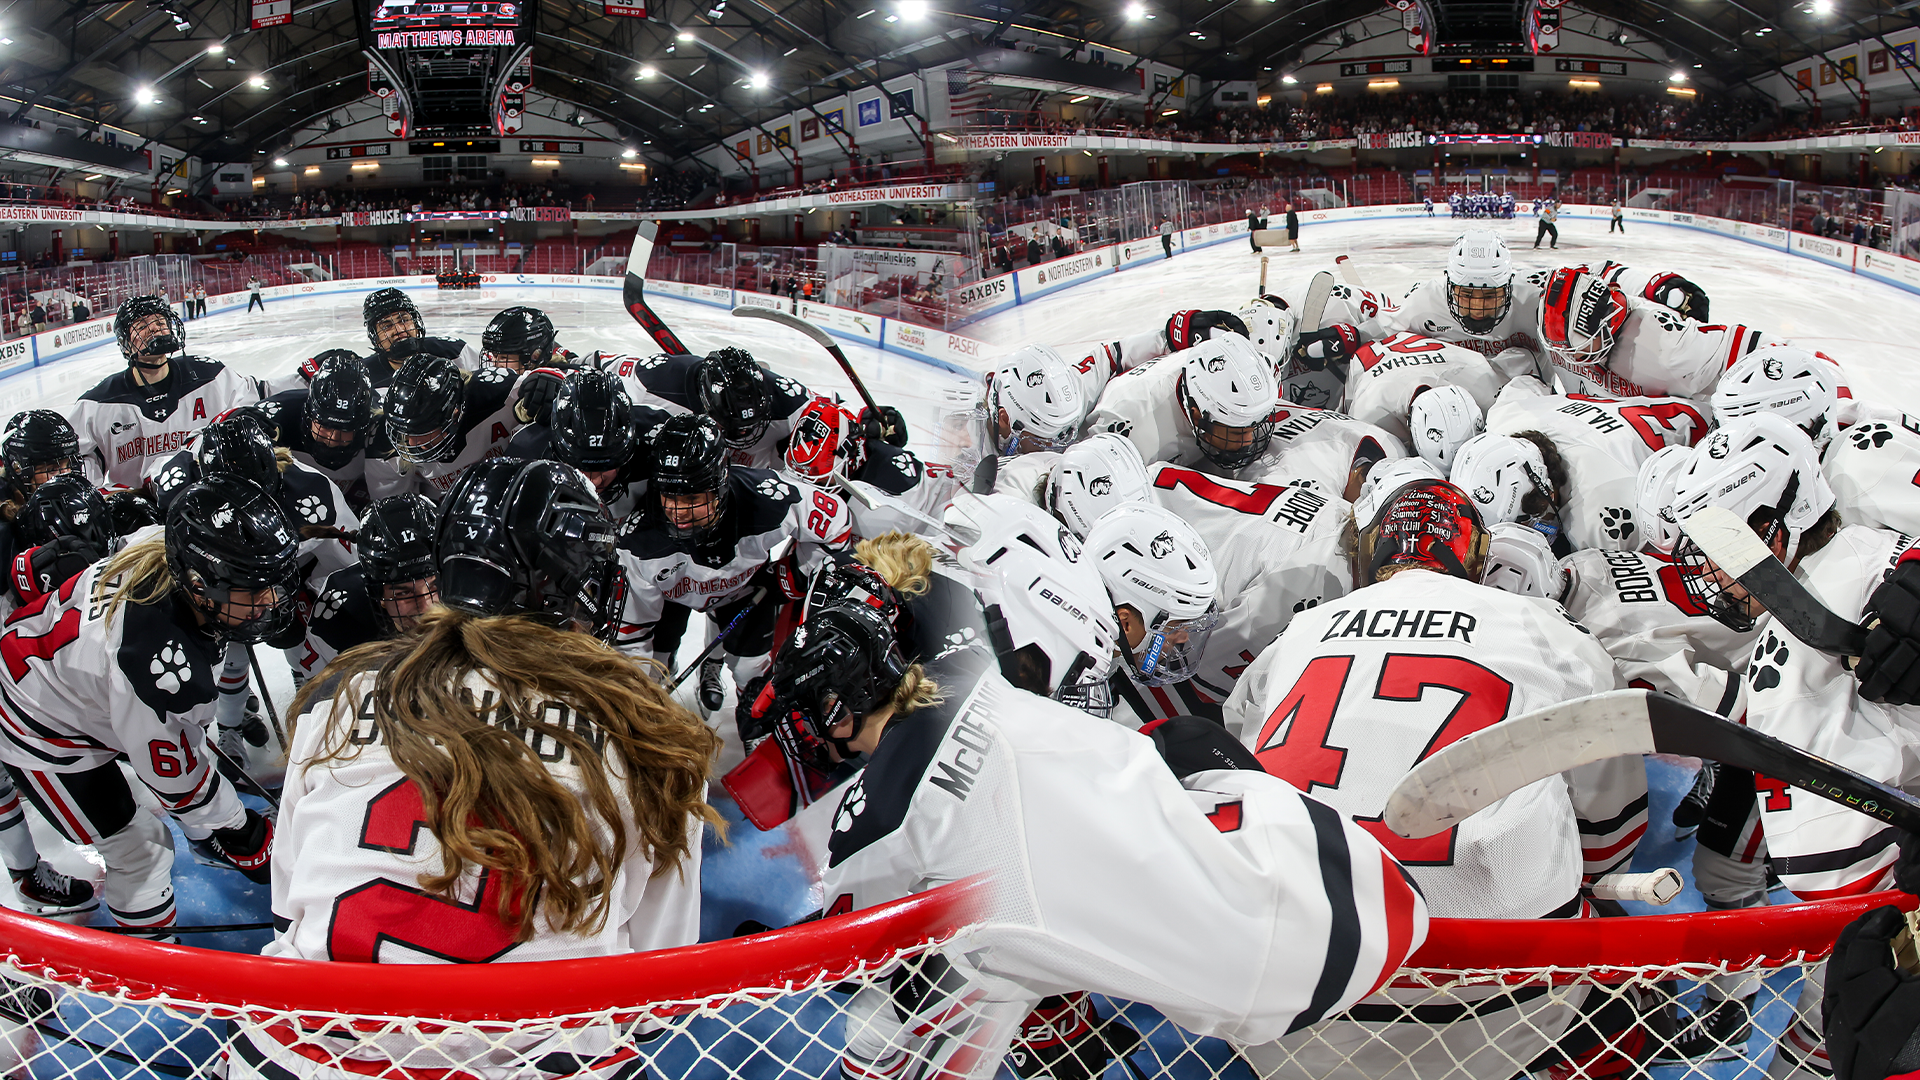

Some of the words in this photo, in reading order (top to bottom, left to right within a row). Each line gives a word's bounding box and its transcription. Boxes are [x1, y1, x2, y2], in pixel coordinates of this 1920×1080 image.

[403, 6, 409, 14] 0
[430, 4, 445, 12] 17.9
[482, 4, 488, 12] 0
[378, 30, 462, 49] MATTHEWS
[465, 30, 516, 46] ARENA
[1354, 64, 1367, 74] THE
[1384, 62, 1408, 72] HOUSE
[1569, 61, 1583, 71] THE
[1600, 63, 1623, 73] HOUSE
[532, 142, 544, 151] THE
[559, 143, 580, 152] HOUSE
[1022, 136, 1068, 147] UNIVERSITY
[1897, 132, 1920, 144] NORT
[339, 147, 351, 158] THE
[366, 145, 387, 155] HOUSE
[828, 189, 885, 204] NORTHEASTERN
[889, 186, 943, 199] UNIVERSITY
[0, 208, 38, 220] EASTERN
[41, 209, 83, 221] UNIVERSITY
[1312, 211, 1328, 220] COX
[1048, 257, 1094, 281] NORTHEASTERN
[376, 278, 407, 286] POWERADE
[960, 279, 1006, 305] SAXBYS
[1574, 279, 1607, 338] HUSKIES
[63, 323, 105, 346] NORTHEASTERN
[897, 333, 925, 347] TAQUERIA
[948, 335, 980, 358] PASEK
[1371, 352, 1447, 378] PECHAR
[145, 393, 168, 403] CCM
[336, 399, 349, 410] 92
[1770, 395, 1803, 409] BAUER
[193, 397, 207, 421] A
[394, 403, 404, 415] 74
[742, 408, 754, 419] 86
[491, 422, 509, 444] A
[589, 435, 603, 447] 27
[117, 430, 193, 465] NORTHEAST
[665, 455, 680, 467] 28
[1718, 471, 1757, 498] BAUER
[471, 495, 488, 515] 2
[808, 490, 838, 539] 28
[1068, 500, 1087, 528] BAUER
[1402, 521, 1420, 531] Will
[588, 532, 615, 544] BAUER
[188, 543, 222, 565] BAUER
[1601, 548, 1659, 603] BORGE
[1130, 577, 1168, 596] BAUER
[577, 590, 598, 614] BAUER
[1039, 587, 1089, 625] BAUER
[1320, 608, 1478, 644] ZACHER
[1141, 634, 1164, 674] BAUER
[795, 664, 825, 685] BAUER
[826, 700, 843, 727] BAUER
[148, 729, 200, 779] 61
[1254, 652, 1514, 867] 47
